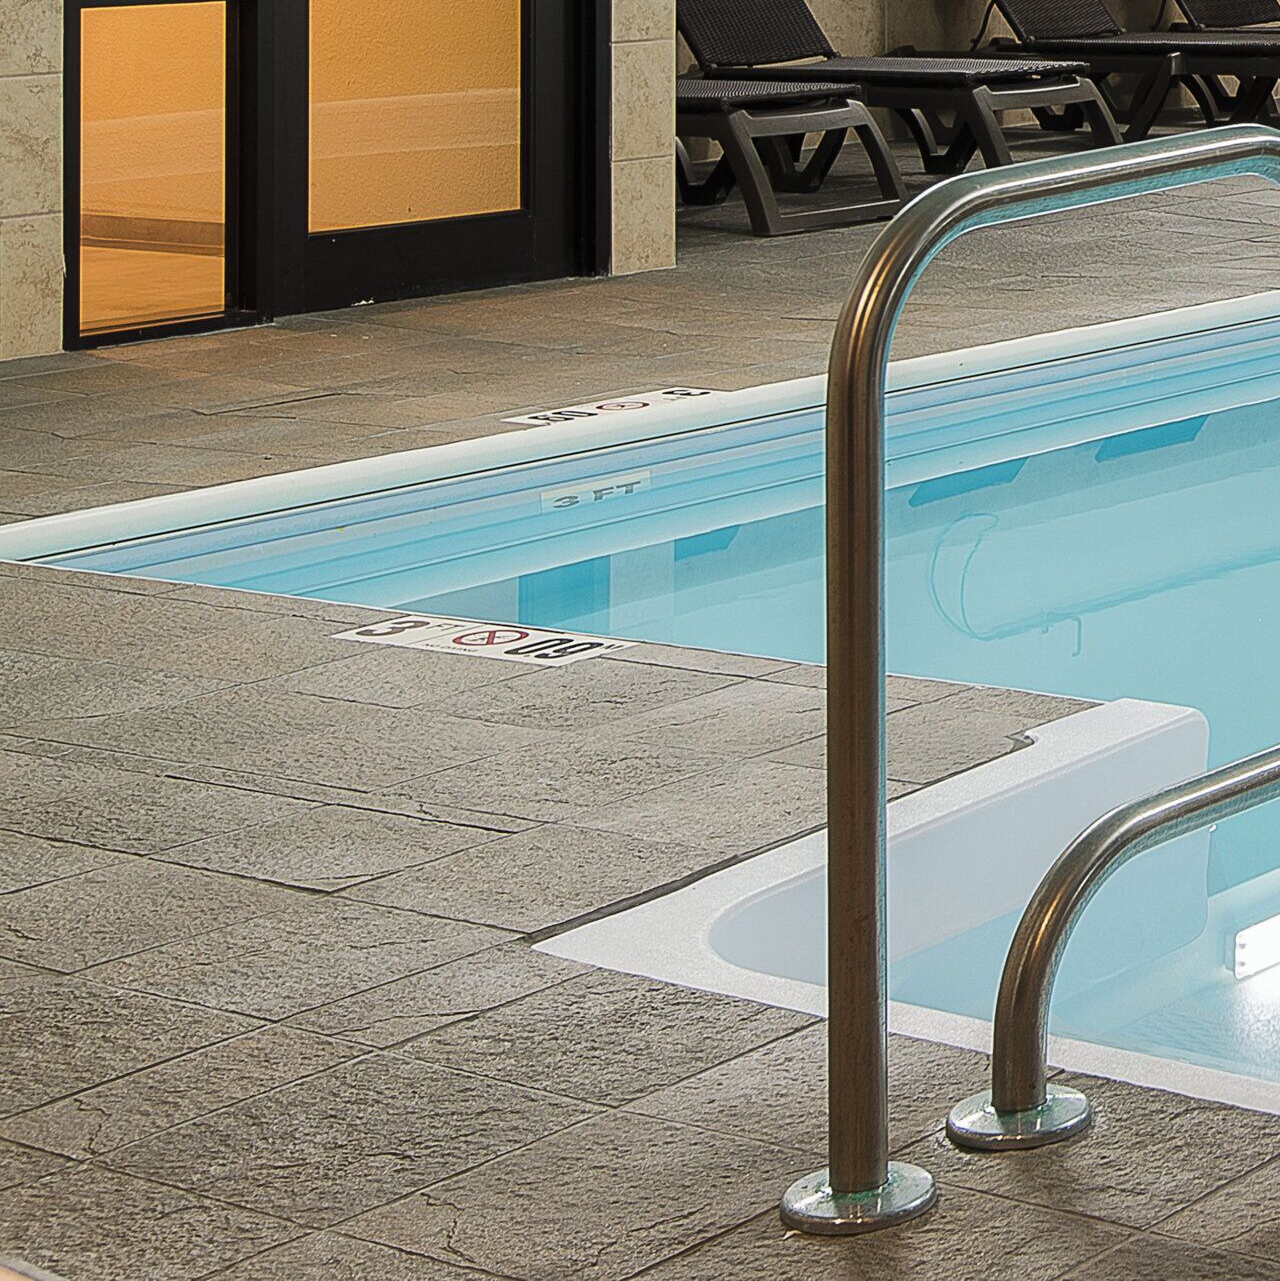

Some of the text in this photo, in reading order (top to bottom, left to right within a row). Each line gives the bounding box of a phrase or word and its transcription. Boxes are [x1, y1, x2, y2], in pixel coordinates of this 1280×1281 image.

[553, 480, 642, 509] 3 FT
[355, 620, 430, 637] 3
